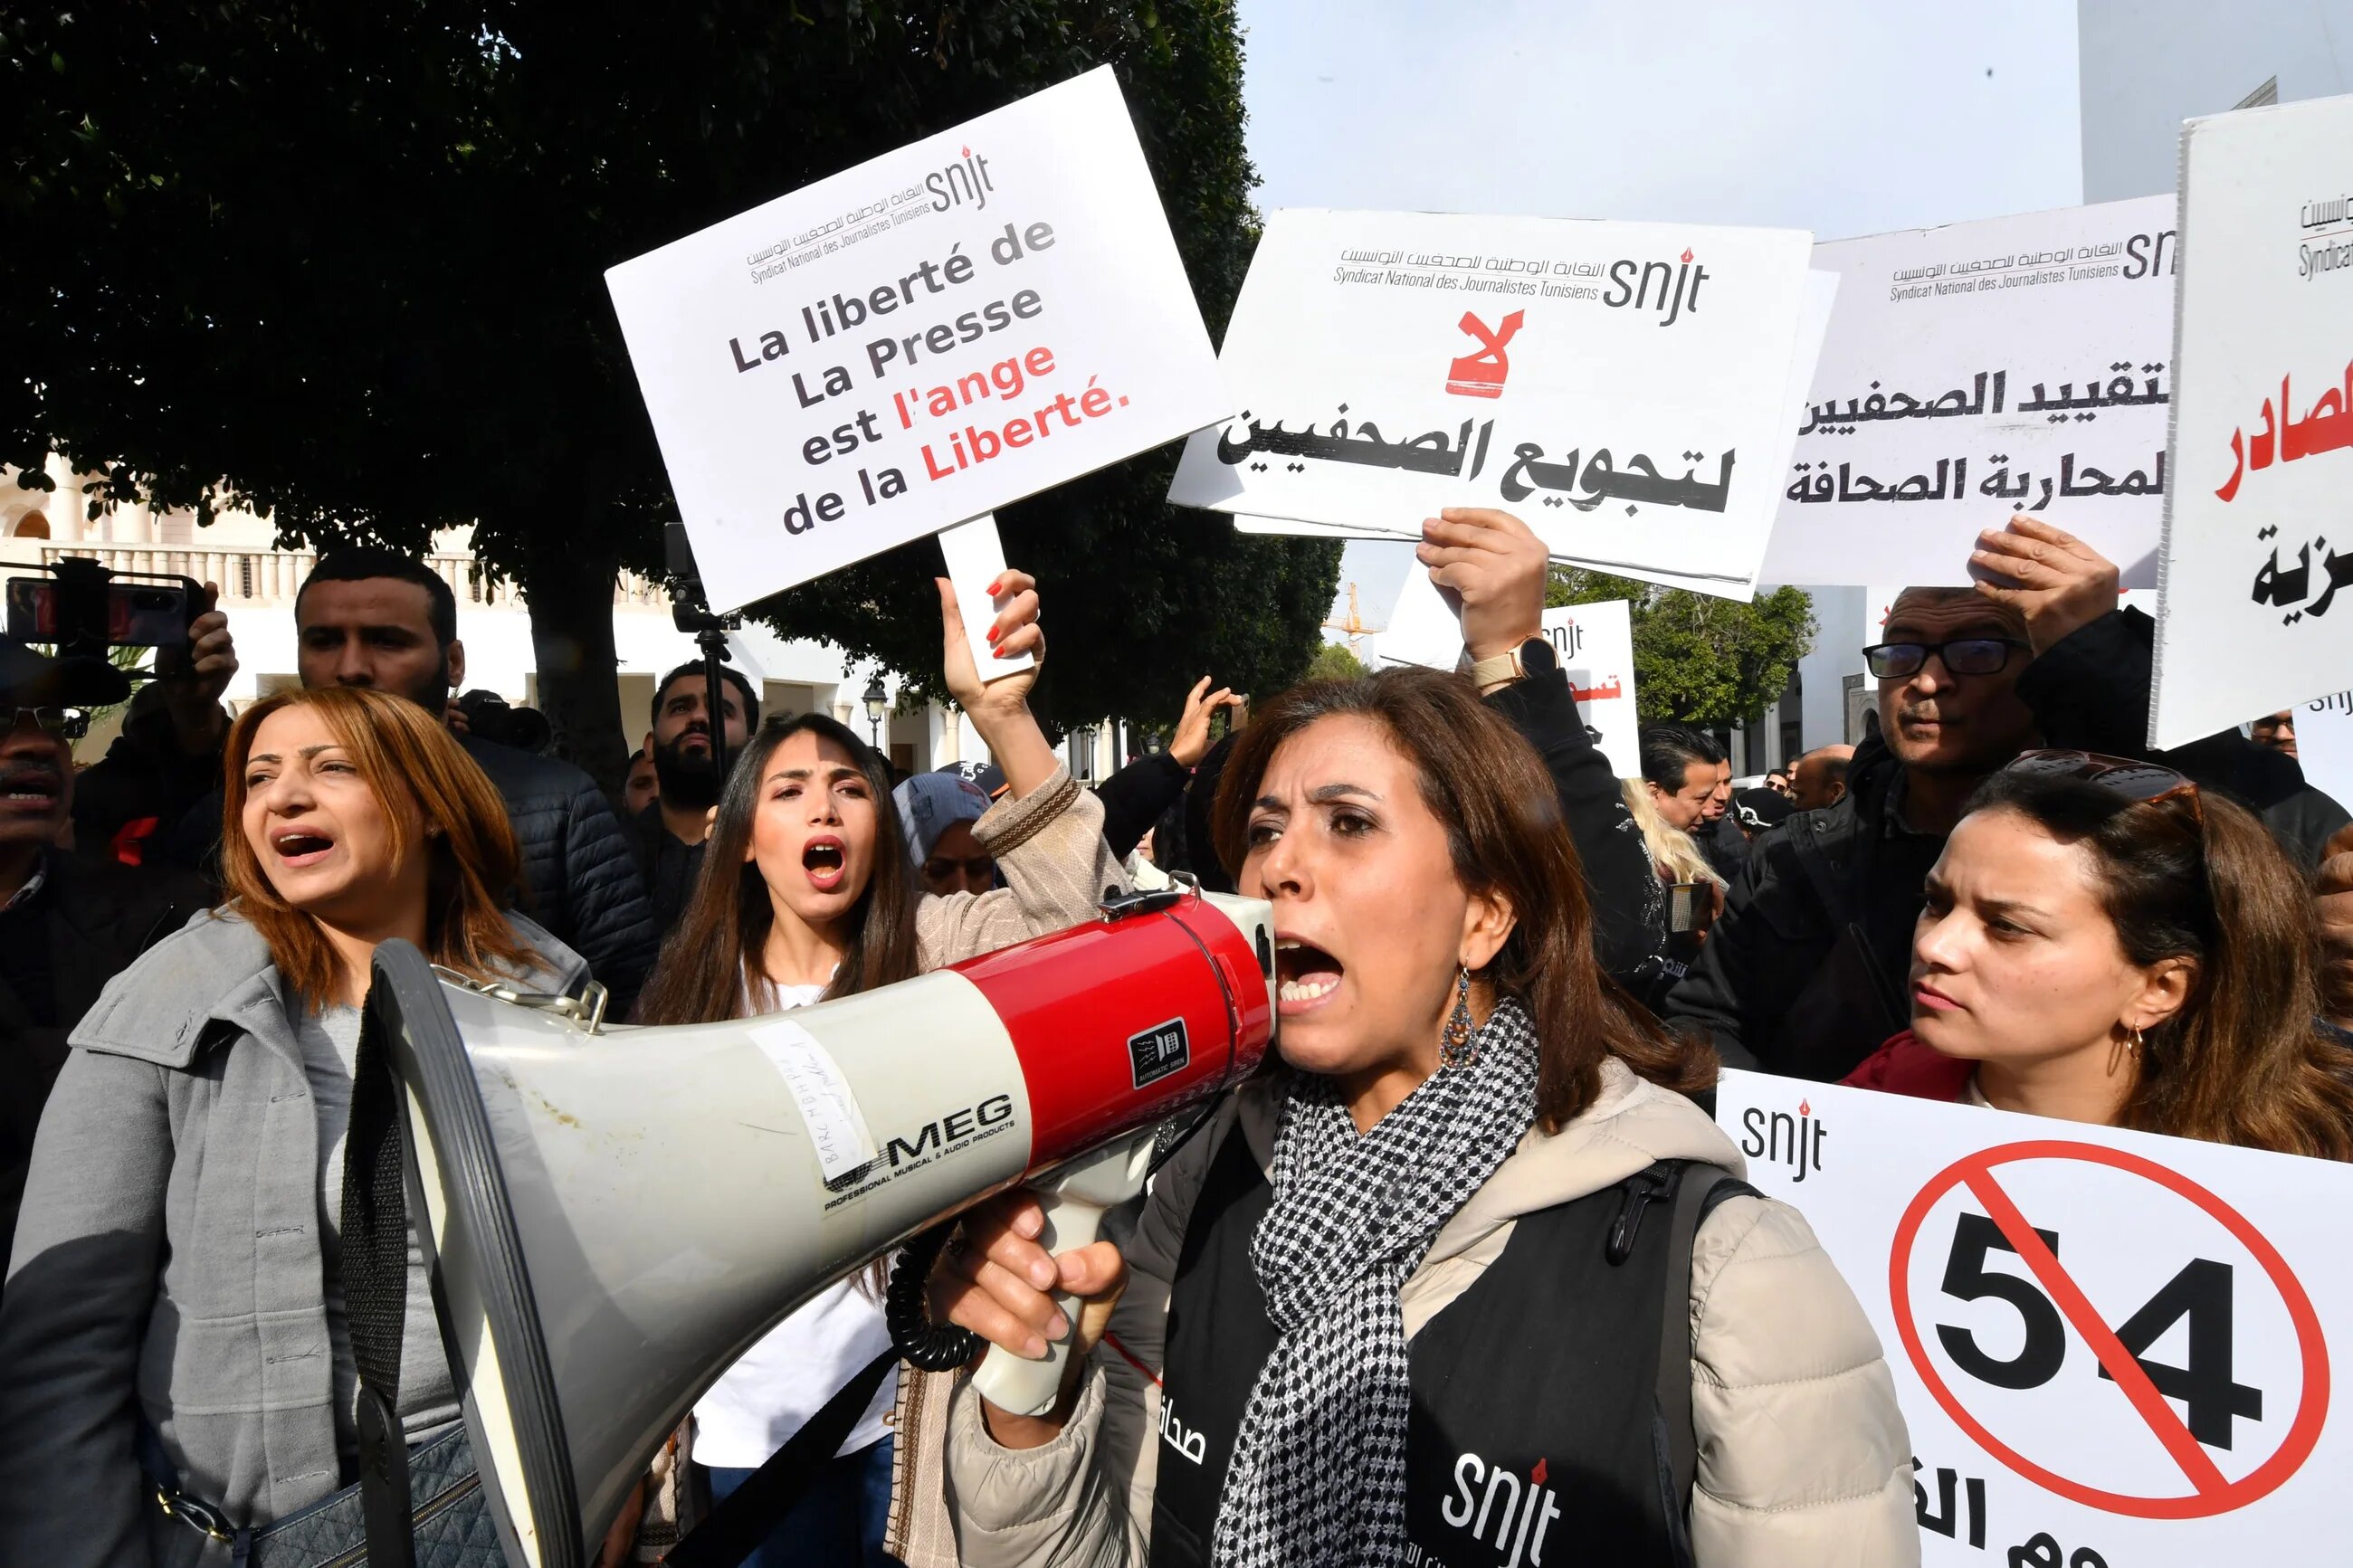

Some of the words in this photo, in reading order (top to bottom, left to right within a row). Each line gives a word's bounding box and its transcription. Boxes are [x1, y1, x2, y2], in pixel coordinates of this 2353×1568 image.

[925, 147, 994, 212] snjt
[750, 261, 787, 285] Syndicat
[786, 245, 823, 268] National
[823, 239, 839, 255] des
[840, 218, 891, 248] Journalistes
[891, 203, 931, 226] Tunisiens
[1333, 266, 1384, 286] Syndicat
[1385, 270, 1434, 289] National
[1435, 273, 1458, 290] des
[1459, 276, 1537, 296] Journalistes
[1539, 280, 1599, 300] Tunisiens
[1890, 283, 1932, 304] Syndicat
[1934, 277, 1976, 297] National
[1978, 278, 1996, 292] des
[1998, 271, 2065, 290] Journalistes
[2068, 264, 2119, 281] Tunisiens
[729, 331, 789, 373] La
[802, 242, 974, 343] liberté
[992, 223, 1054, 265] de
[1603, 247, 1710, 327] snjt
[792, 366, 853, 409] La
[866, 290, 1043, 378] Presse
[1445, 309, 1524, 399] لا
[803, 410, 882, 465] est
[893, 347, 1055, 429] l'ange
[2017, 360, 2169, 423] تقييد
[784, 493, 845, 535] de
[858, 469, 908, 506] la
[921, 375, 1129, 480] Liberté.
[1217, 403, 1494, 482] الصحفيين
[1500, 442, 1735, 518] لتجويع
[1786, 457, 1967, 503] الصحافة
[2252, 524, 2353, 627] زية
[1139, 1064, 1168, 1081] AUTOMATIC
[824, 1175, 891, 1211] PROFESSIONAL
[894, 1157, 932, 1177] MUSICAL
[944, 1139, 969, 1156] AUDIO
[972, 1120, 1015, 1144] PRODUCTS
[887, 1094, 1013, 1167] MEG
[1742, 1098, 1827, 1183] snjt
[1936, 1212, 2262, 1451] 54
[1442, 1453, 1561, 1568] snjt
